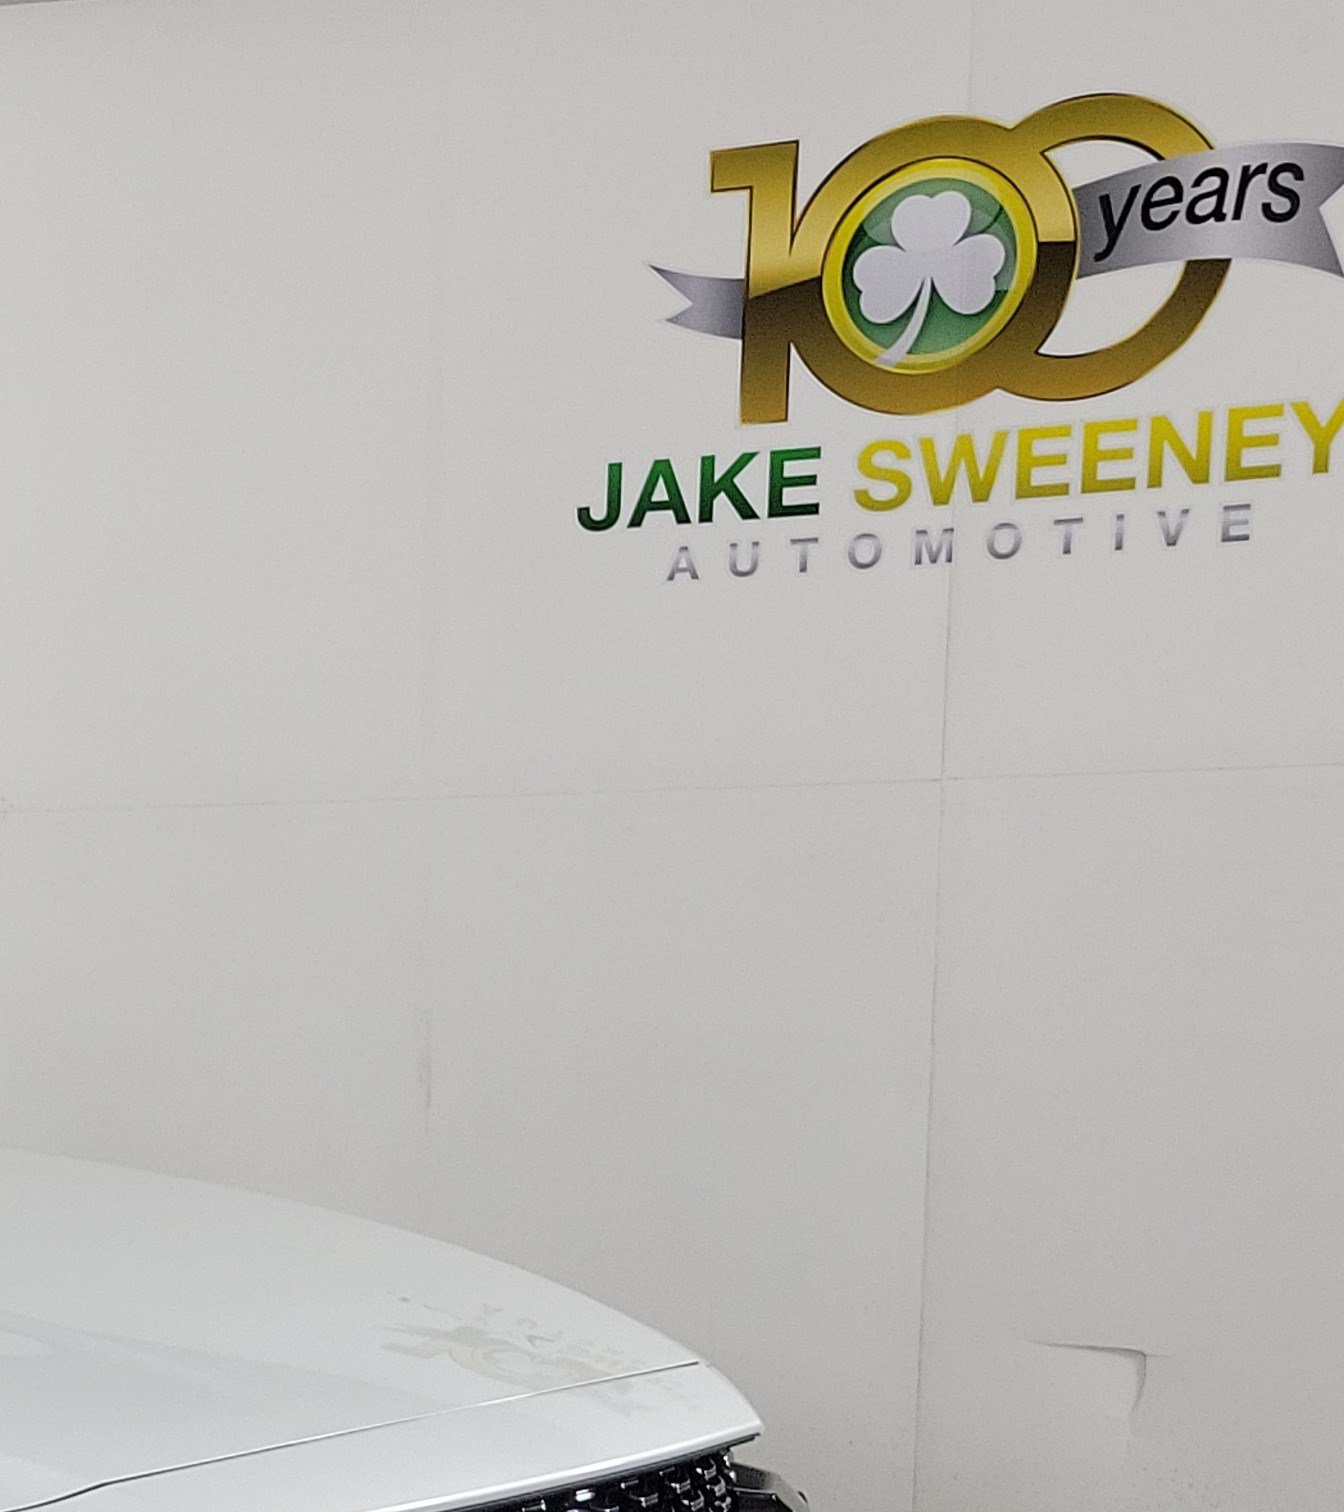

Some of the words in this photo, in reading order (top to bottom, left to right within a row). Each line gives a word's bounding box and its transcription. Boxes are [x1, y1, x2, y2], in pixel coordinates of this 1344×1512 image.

[1094, 161, 1305, 261] years
[576, 446, 823, 533] JAKE
[852, 396, 1344, 512] SWEENEY
[666, 503, 1254, 582] AUTOMOTIVE
